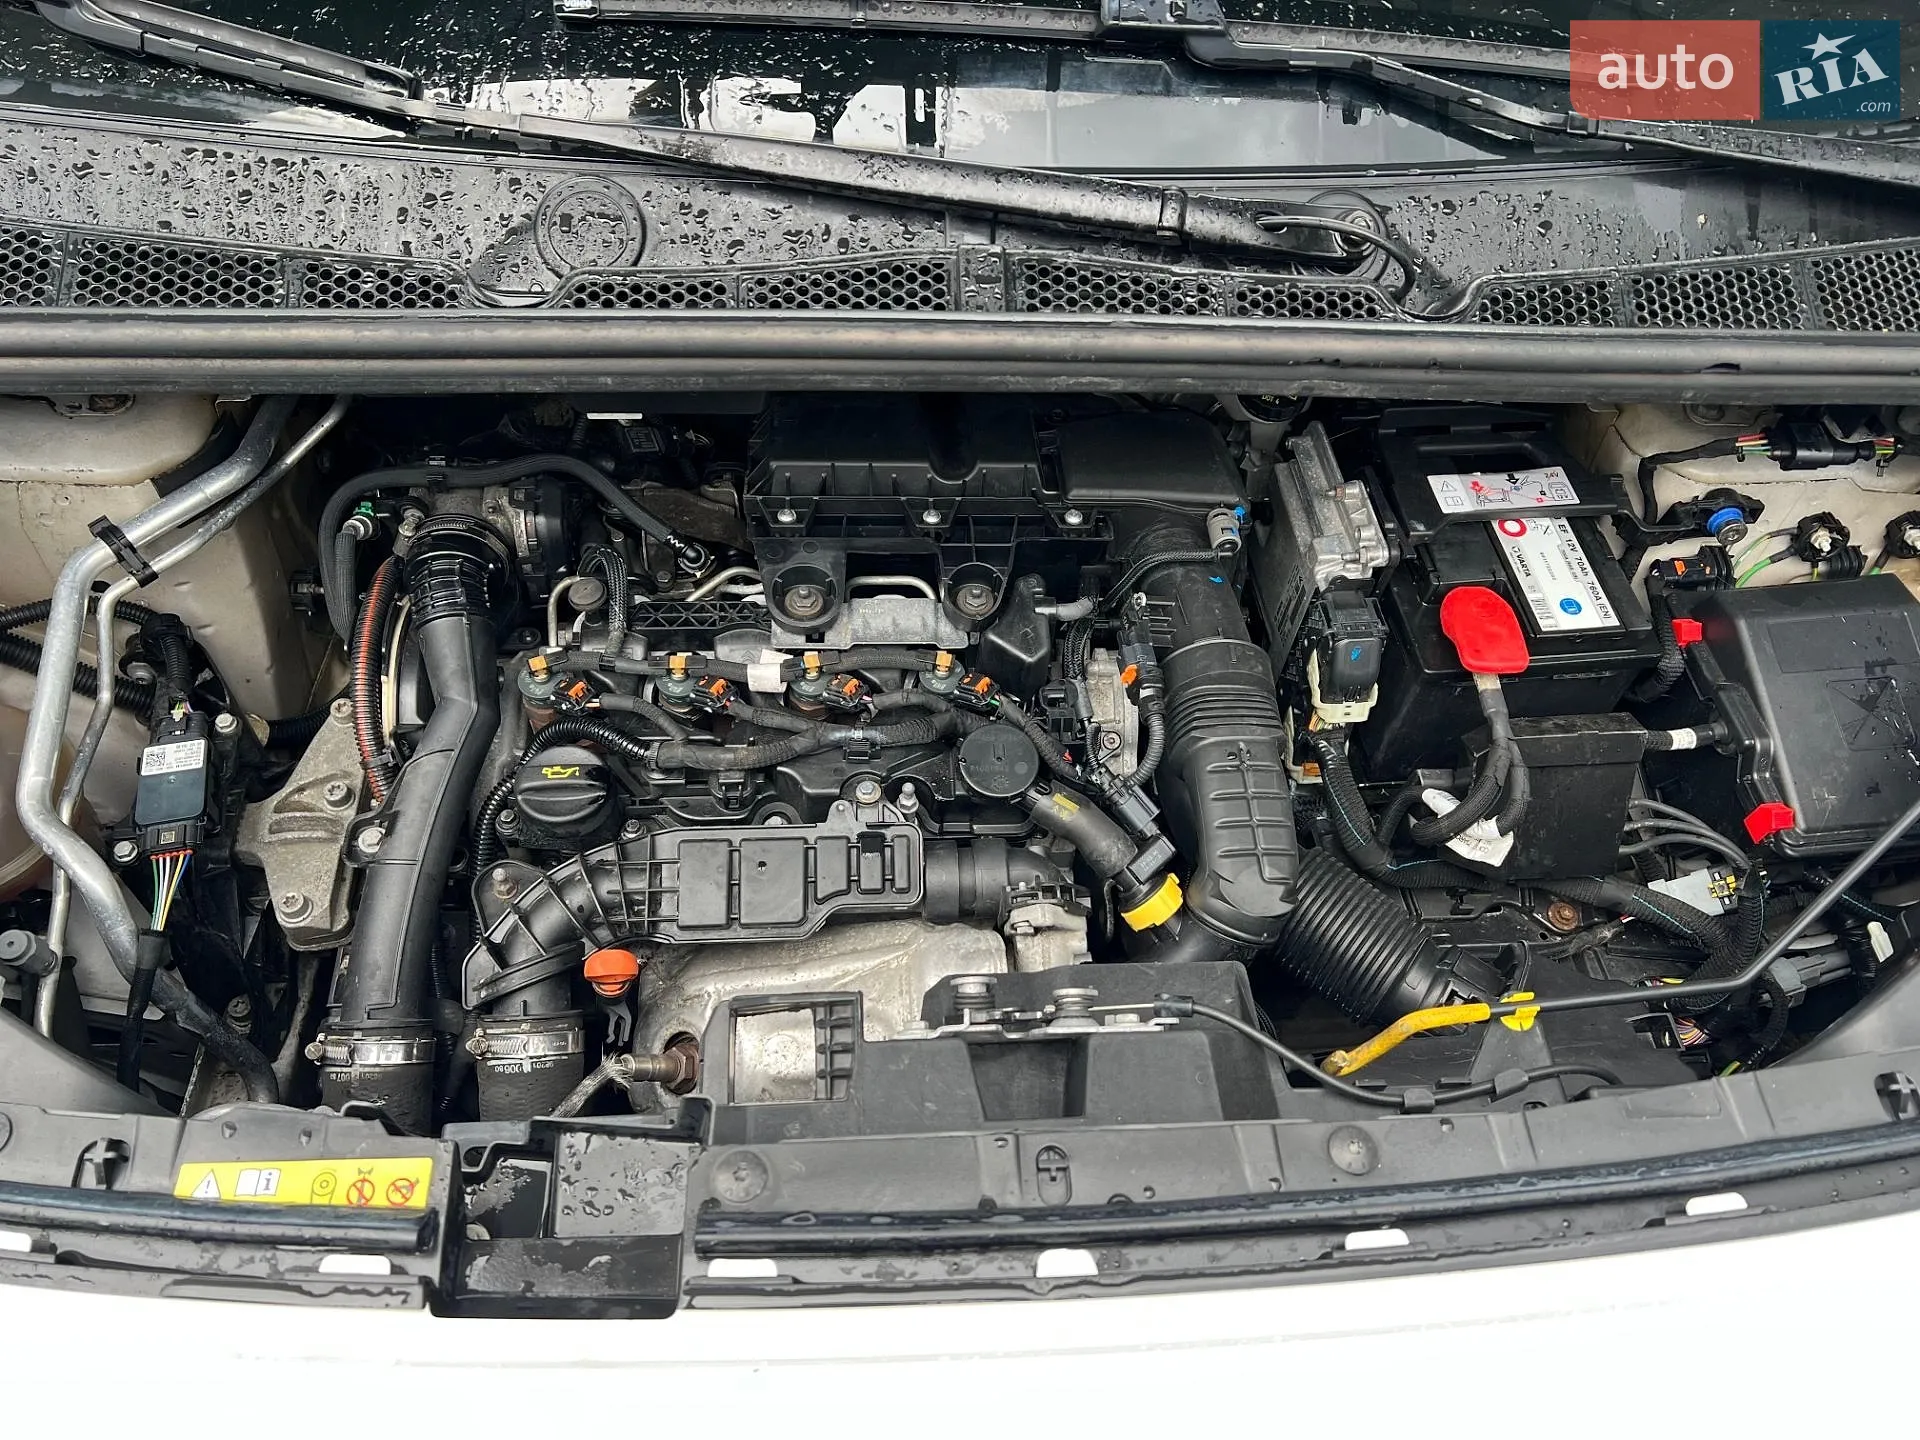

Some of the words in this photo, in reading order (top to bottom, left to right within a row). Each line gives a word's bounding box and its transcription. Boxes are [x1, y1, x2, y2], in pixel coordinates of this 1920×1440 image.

[1517, 553, 1532, 578] VARTA
[1566, 539, 1579, 553] 12V
[1575, 557, 1589, 577] 70Ah
[1587, 581, 1602, 601] 760A
[1596, 602, 1612, 619] (EN)
